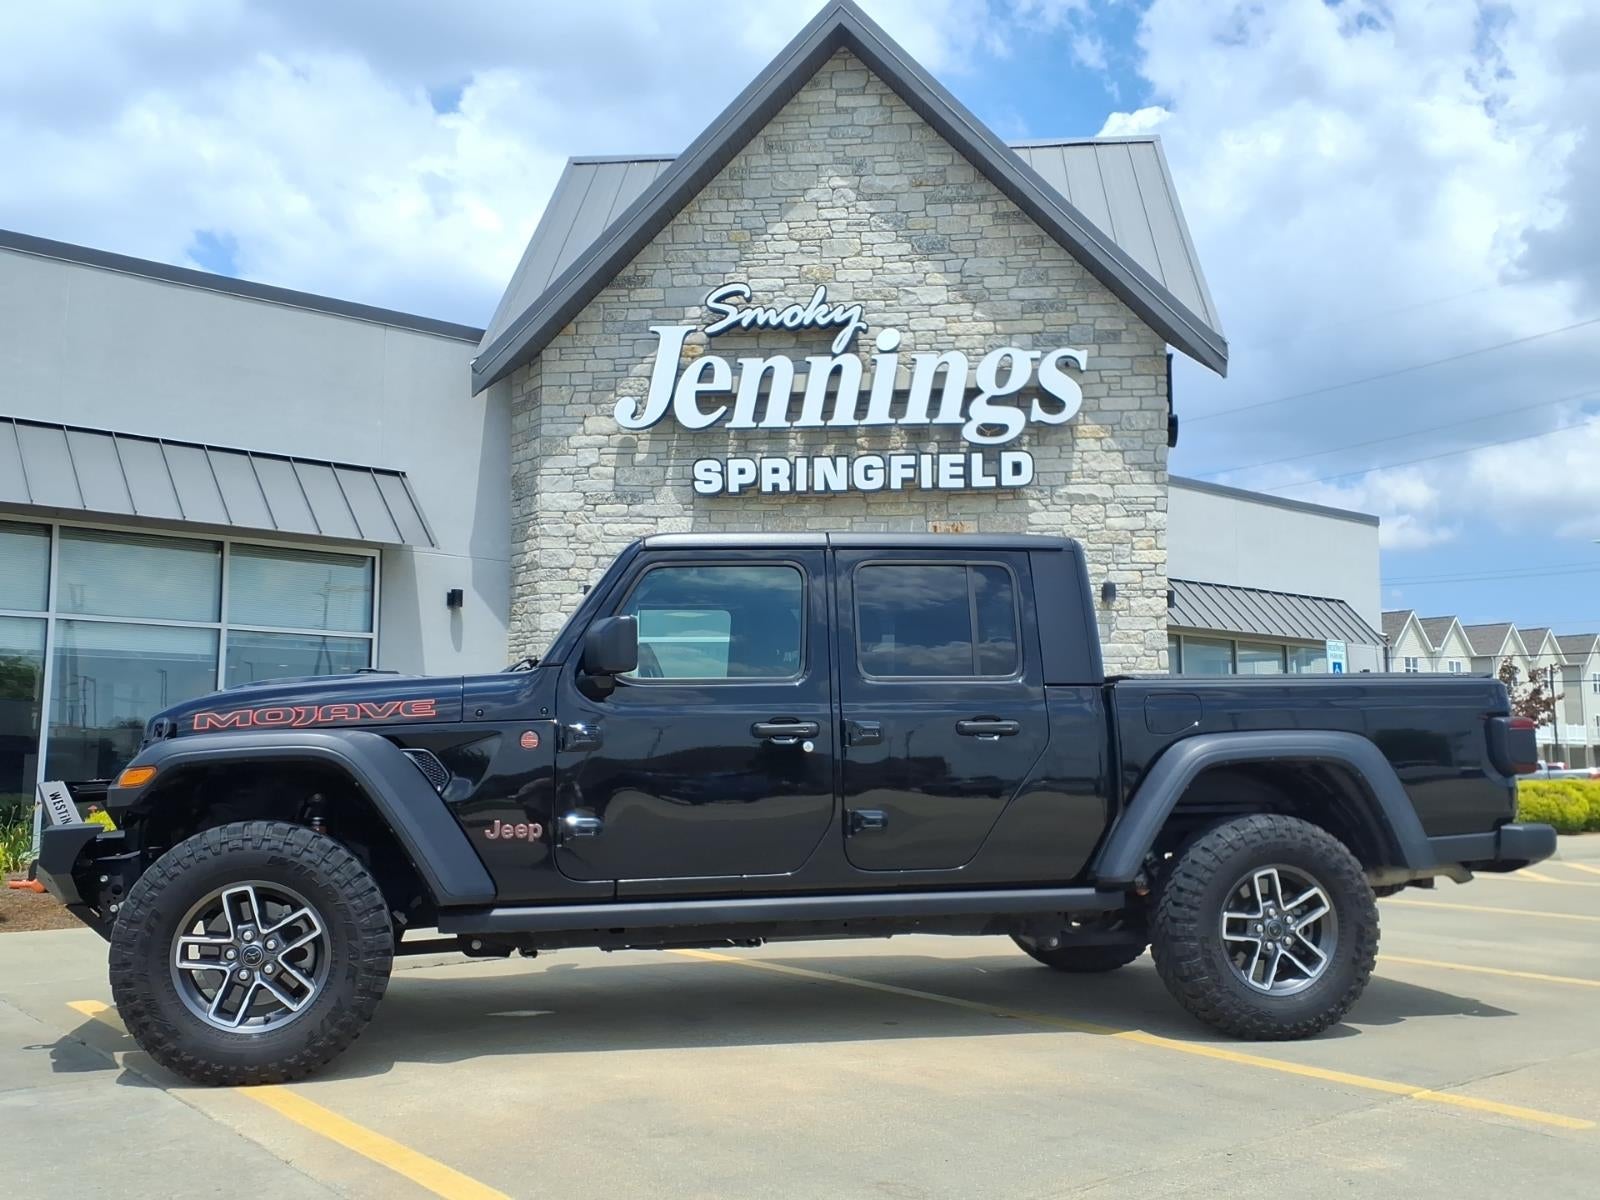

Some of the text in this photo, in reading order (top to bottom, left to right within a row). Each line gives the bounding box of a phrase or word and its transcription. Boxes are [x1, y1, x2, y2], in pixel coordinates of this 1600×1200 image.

[705, 282, 868, 354] Smoky
[613, 326, 1088, 446] Jennings
[693, 450, 1034, 495] SPRINGFIELD
[193, 699, 436, 730] MOJAVE
[484, 819, 543, 841] Jeep
